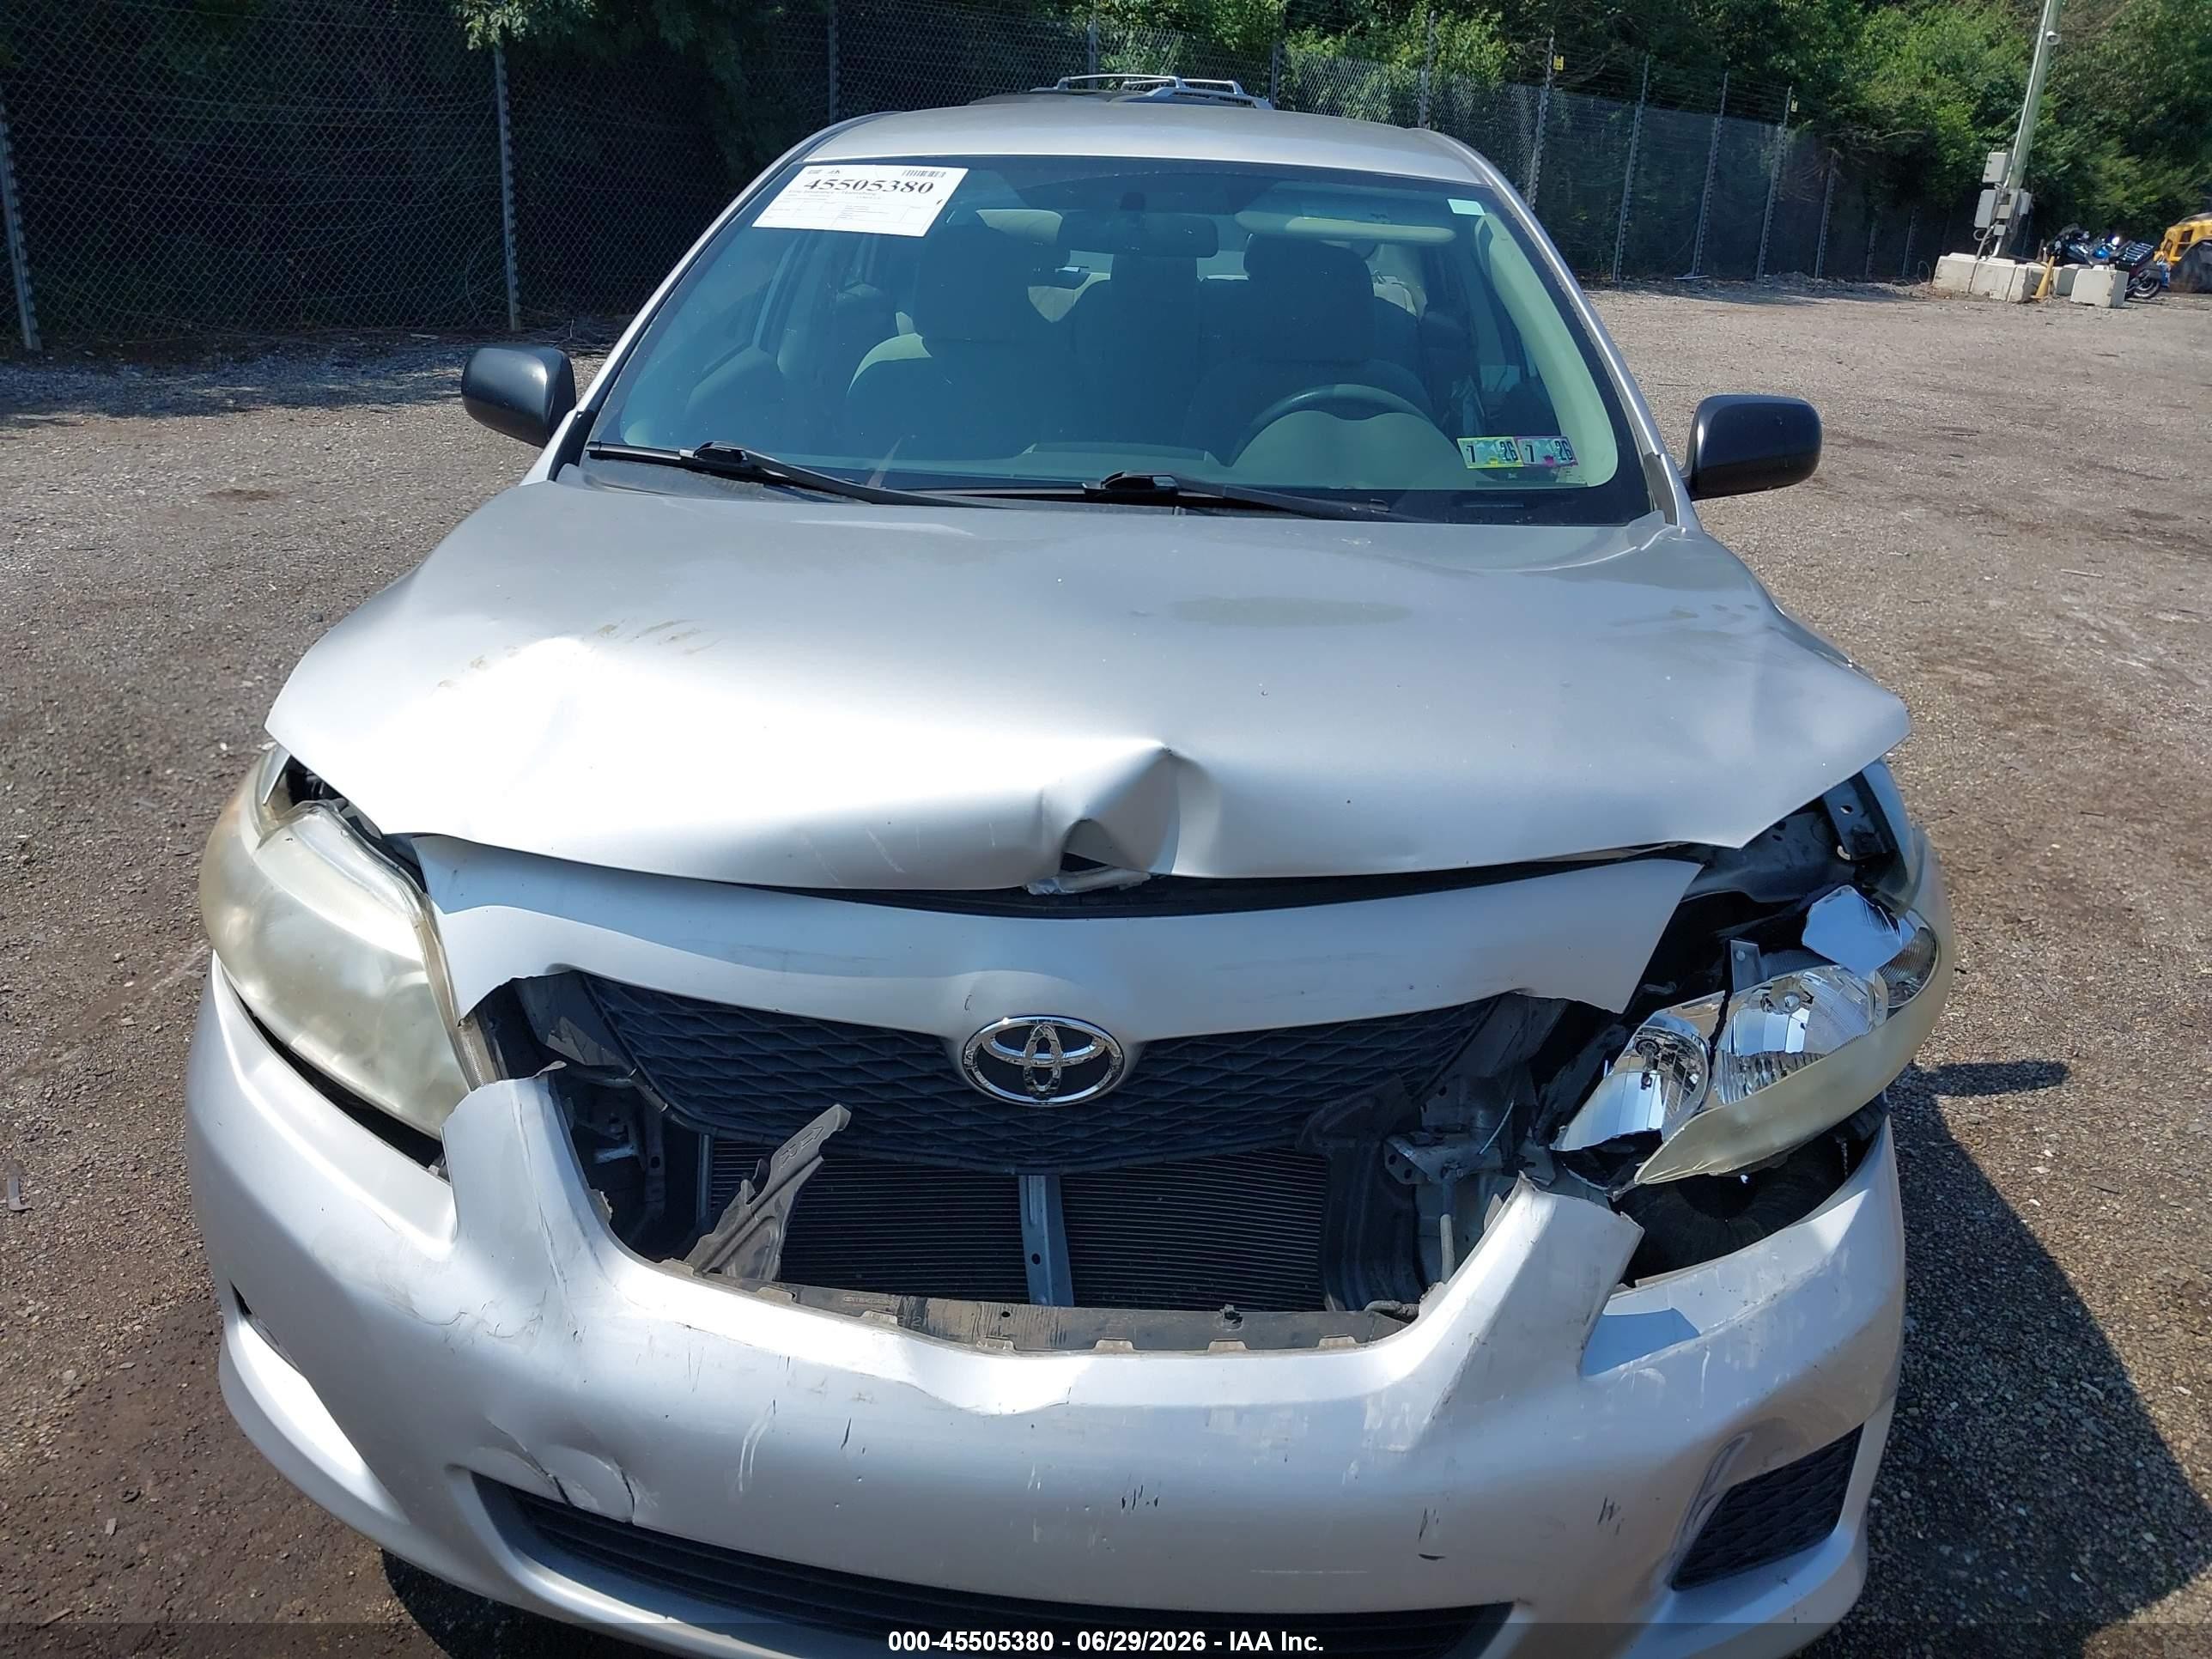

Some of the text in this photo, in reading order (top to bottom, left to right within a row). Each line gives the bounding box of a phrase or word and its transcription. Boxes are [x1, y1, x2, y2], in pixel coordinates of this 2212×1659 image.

[804, 179, 934, 194] 45505380
[1467, 441, 1519, 463] 7 26
[1524, 440, 1573, 463] 7 26
